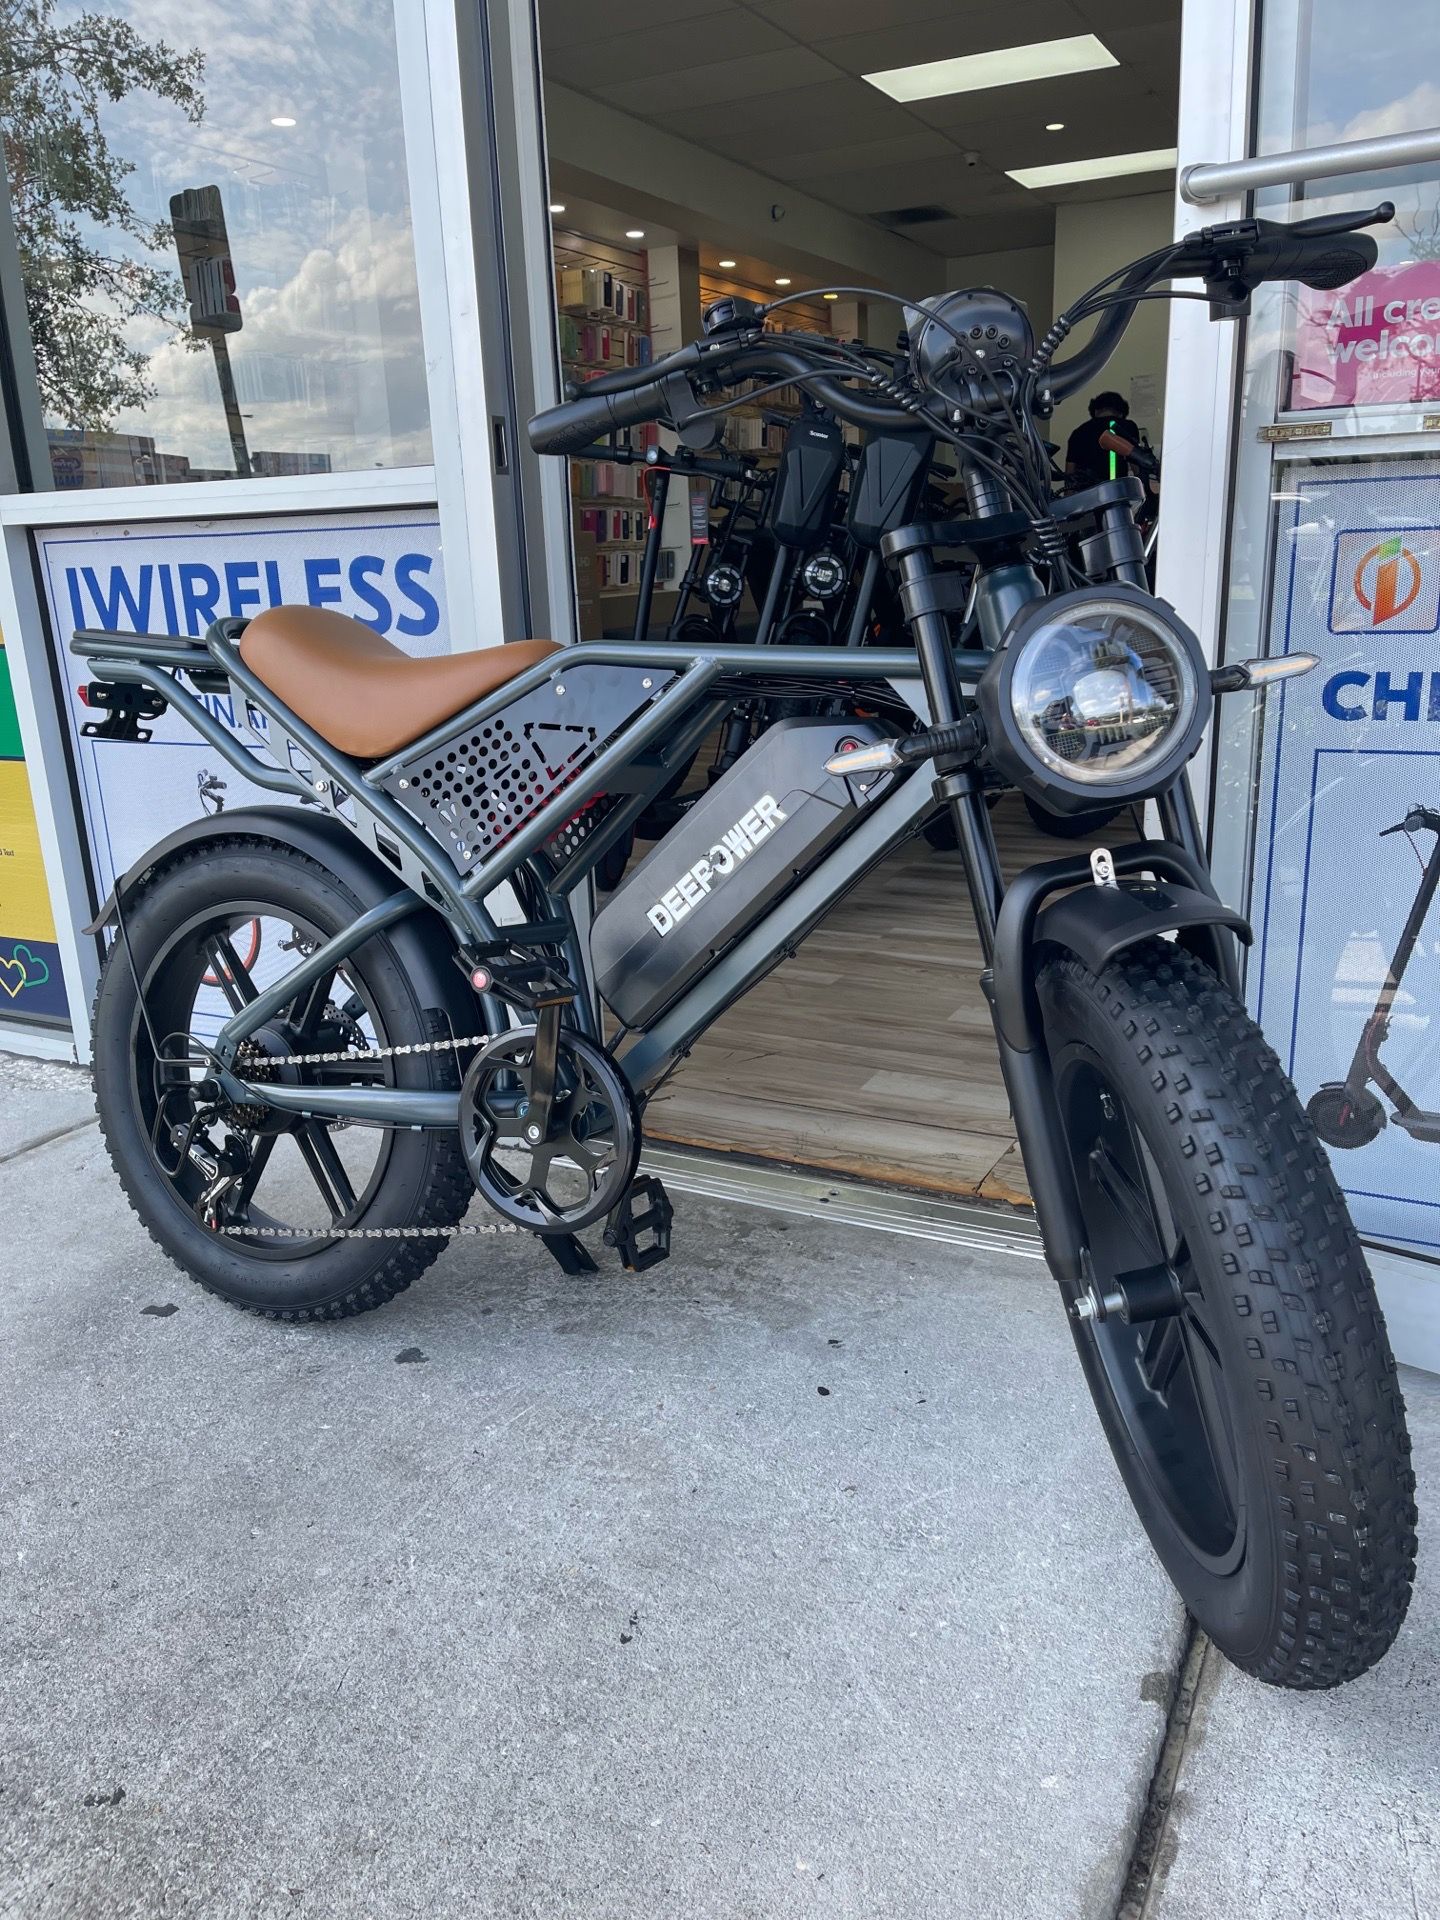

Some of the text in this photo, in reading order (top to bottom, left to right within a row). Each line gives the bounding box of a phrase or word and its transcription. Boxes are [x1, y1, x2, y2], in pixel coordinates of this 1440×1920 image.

[1326, 296, 1373, 329] All
[1326, 330, 1440, 364] welco
[646, 794, 788, 937] DEEPOWER
